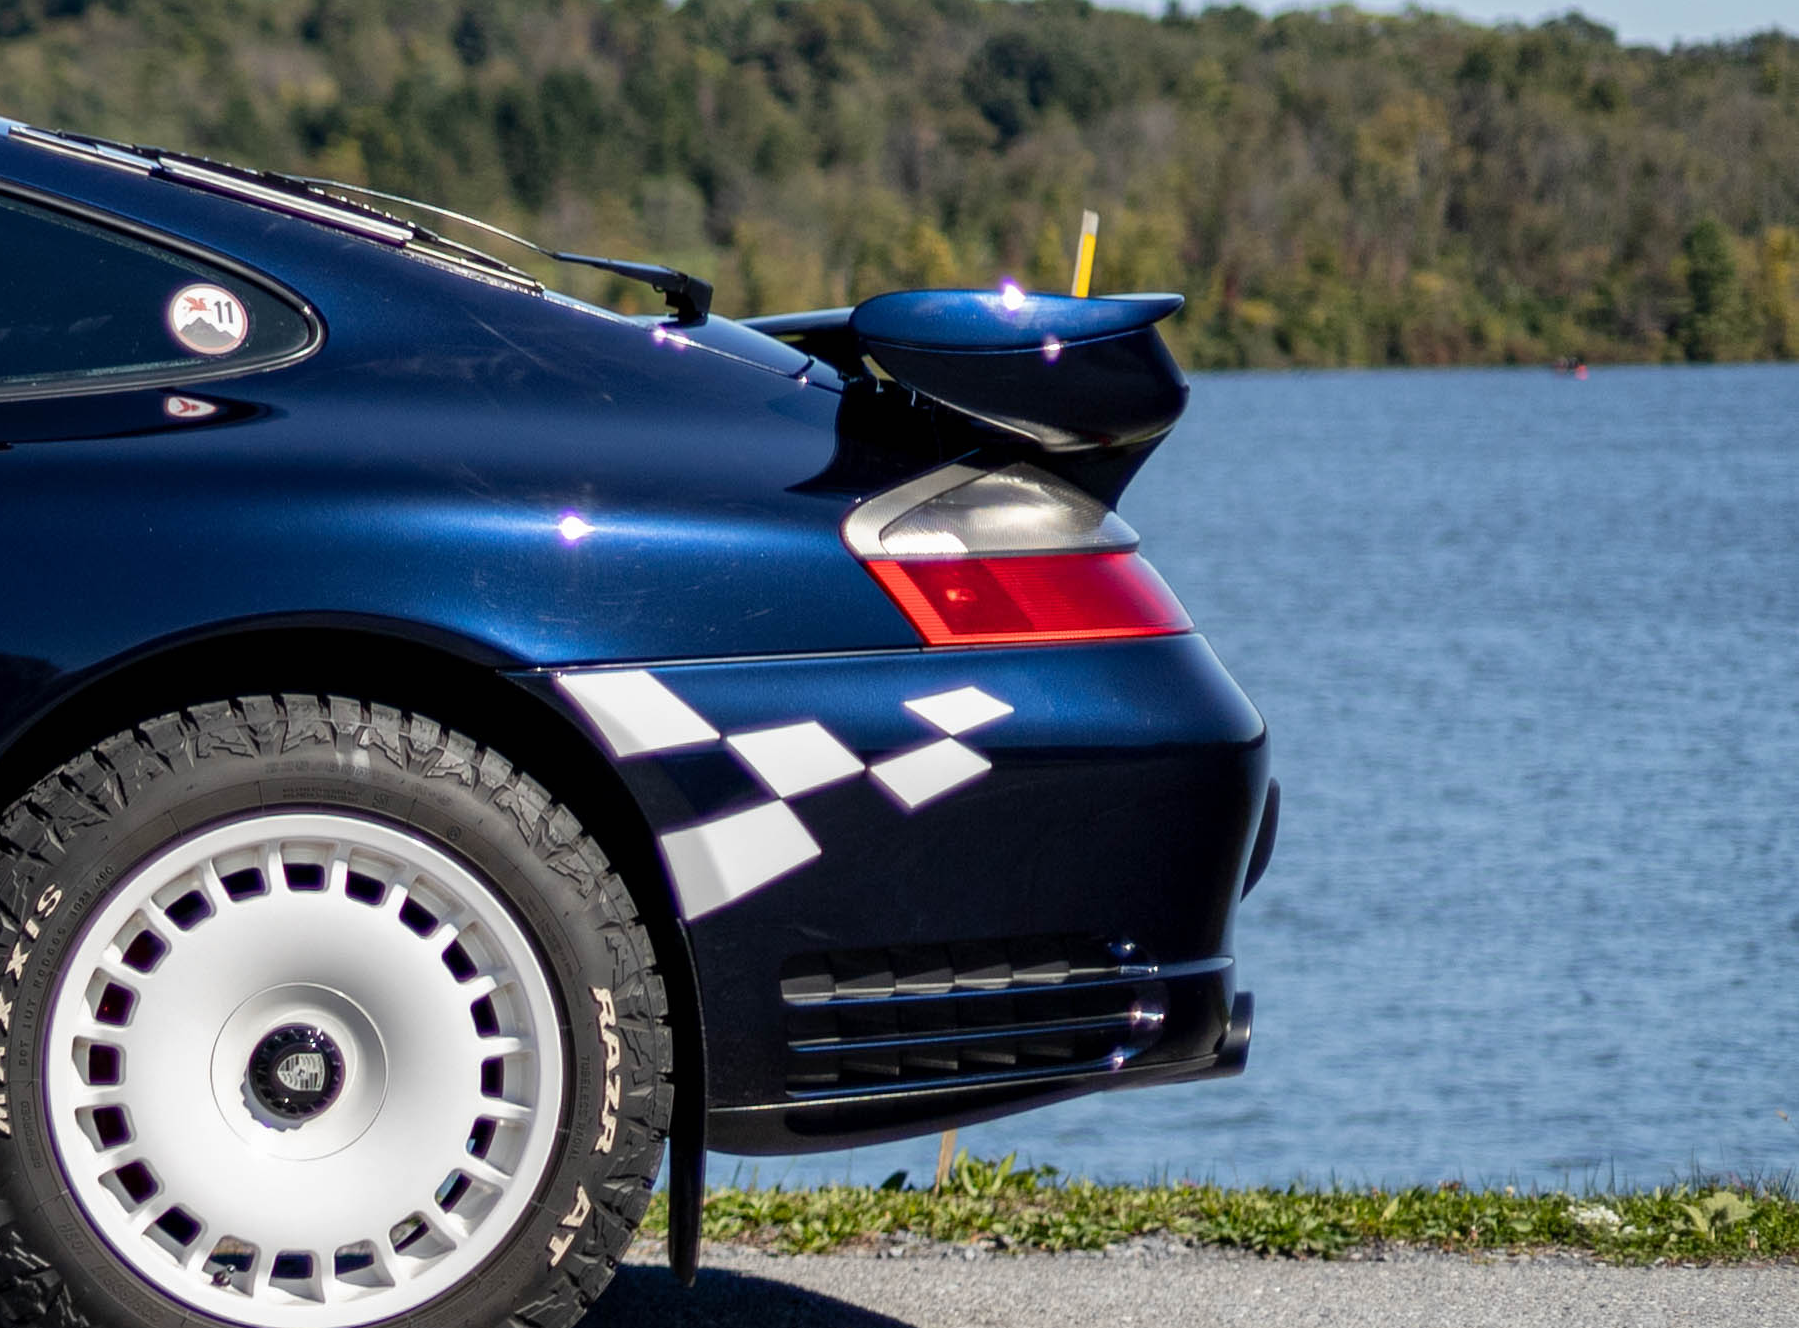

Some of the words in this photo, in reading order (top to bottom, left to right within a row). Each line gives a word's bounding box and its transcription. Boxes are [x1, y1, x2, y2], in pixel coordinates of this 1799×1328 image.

[214, 300, 234, 324] 11
[588, 985, 621, 1156] RAZR
[548, 1183, 592, 1268] AT
